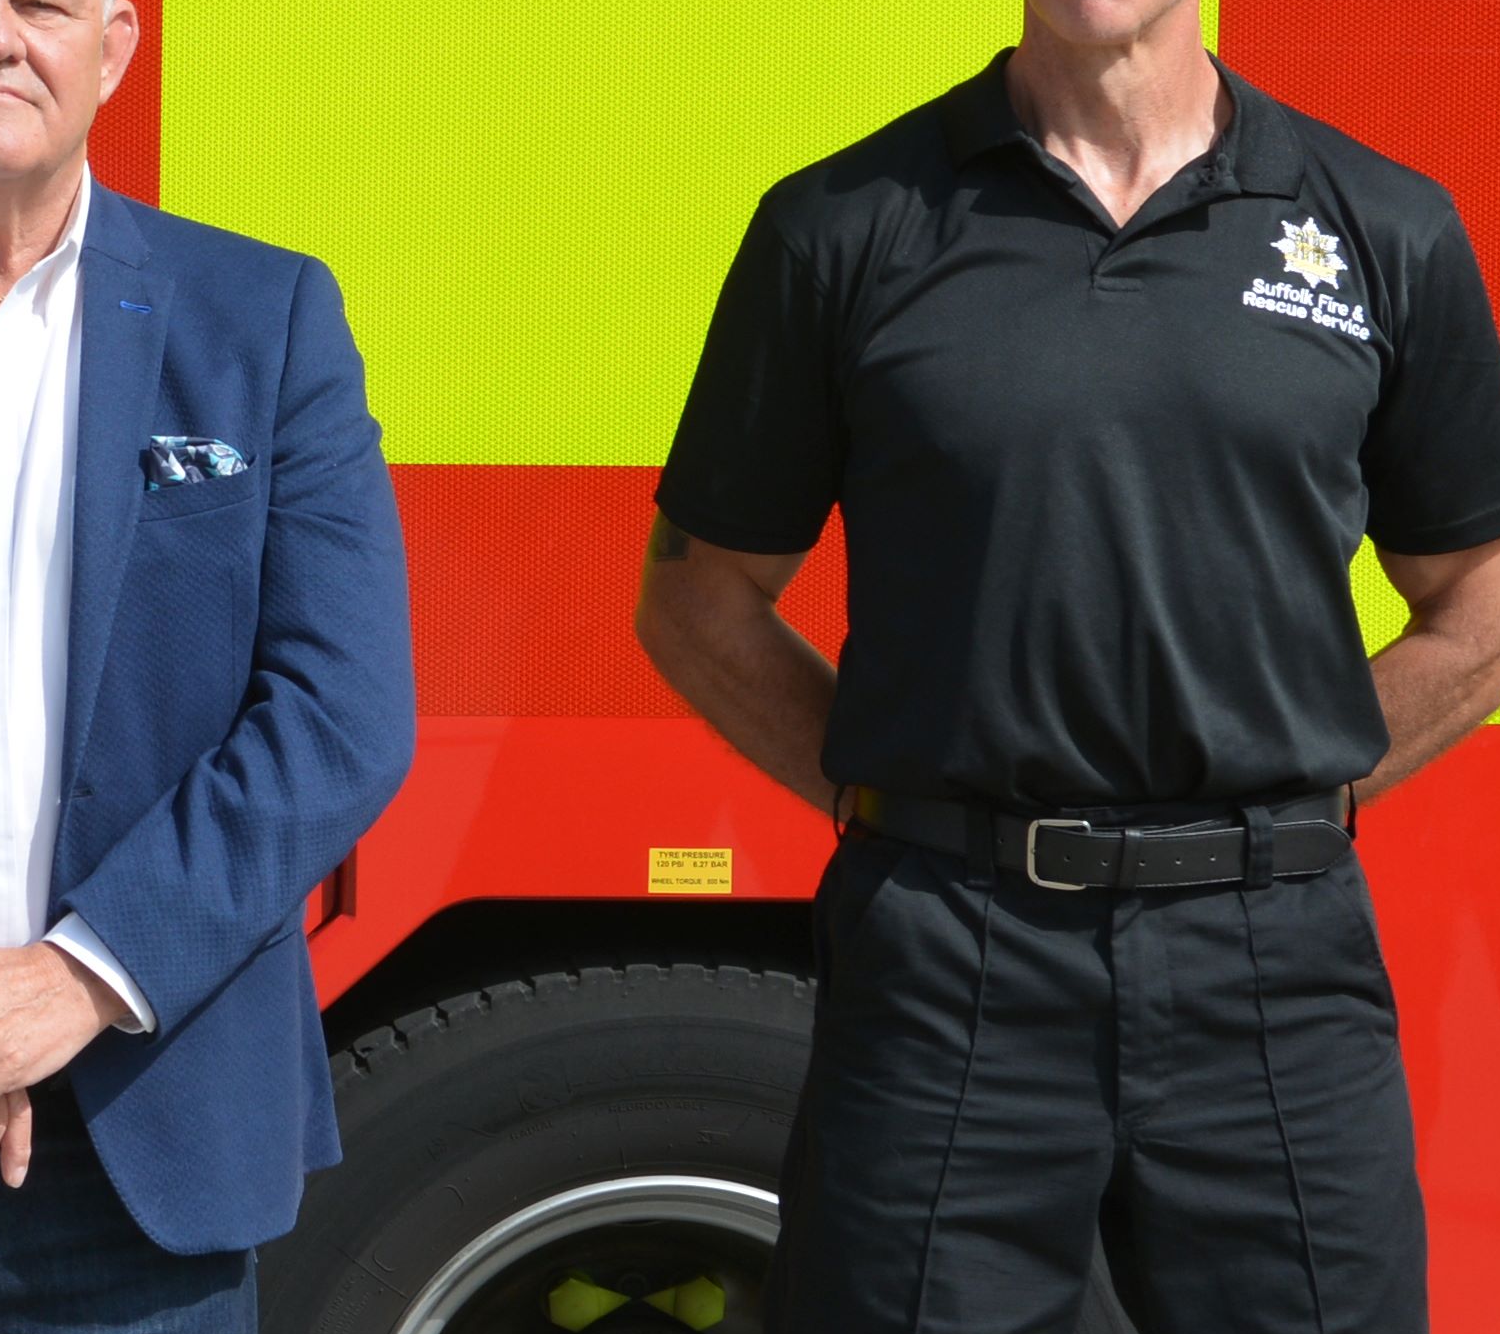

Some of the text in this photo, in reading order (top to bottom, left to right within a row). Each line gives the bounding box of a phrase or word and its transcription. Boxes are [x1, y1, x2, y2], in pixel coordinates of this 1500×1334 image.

[1252, 278, 1364, 324] Suffolk Fire &
[1242, 290, 1371, 341] Rescue Service
[658, 851, 726, 859] TYRE PRESSURE
[711, 860, 728, 868] BAR
